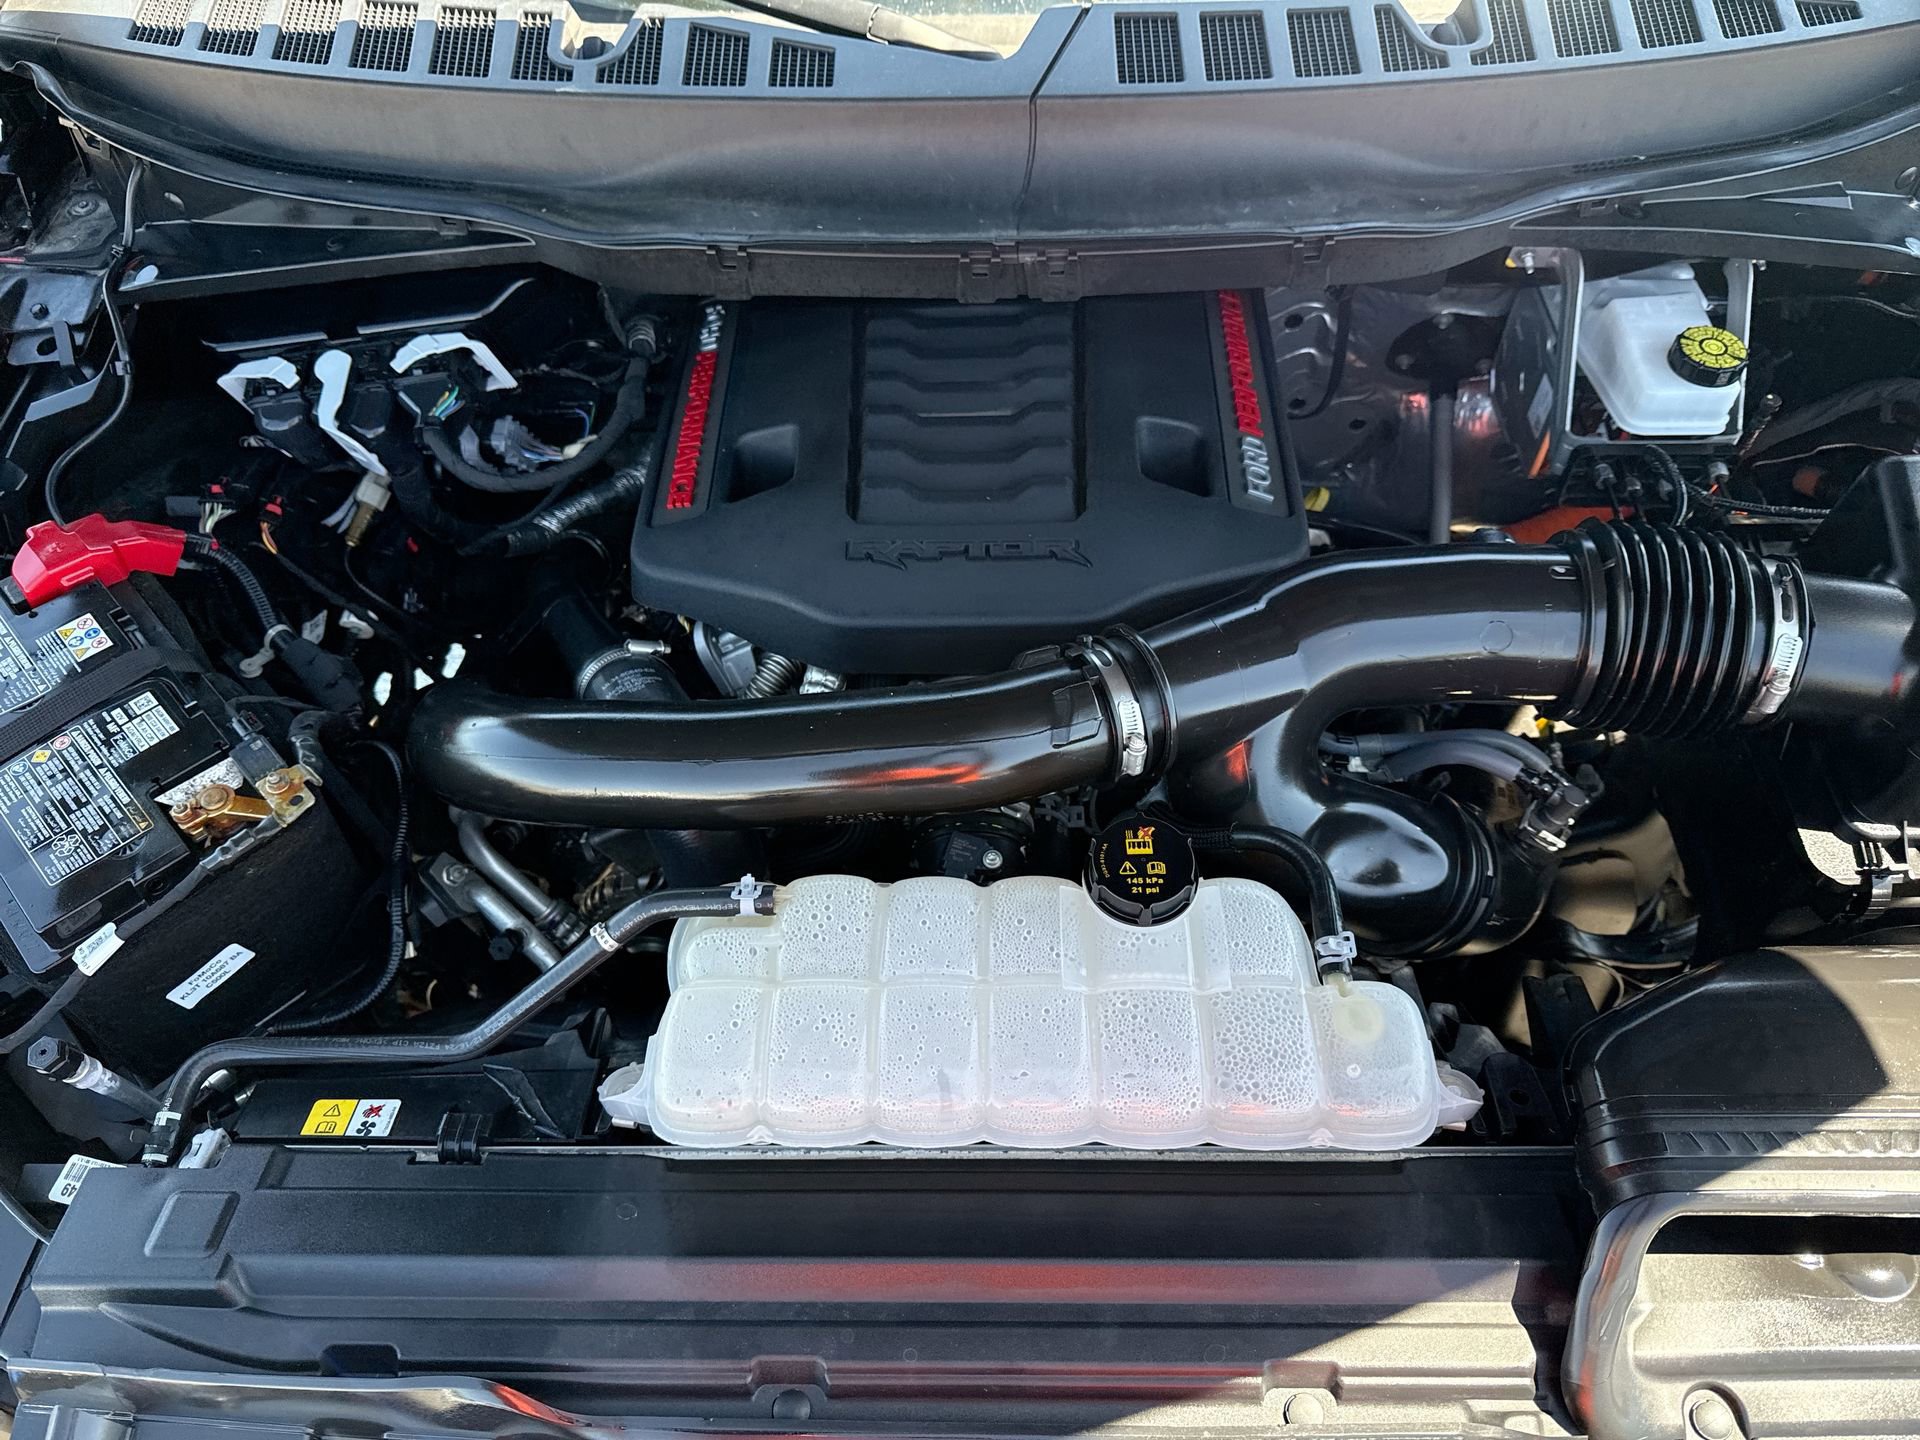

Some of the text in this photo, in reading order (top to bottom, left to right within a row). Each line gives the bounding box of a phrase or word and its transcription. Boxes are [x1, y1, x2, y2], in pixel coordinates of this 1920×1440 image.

[666, 352, 718, 510] PERFORMANCE
[1240, 436, 1275, 505] FORD
[845, 539, 1094, 571] RAPTOR
[1126, 877, 1164, 885] 145 kPa
[1146, 887, 1160, 895] psi
[188, 959, 222, 985] FoMoCo
